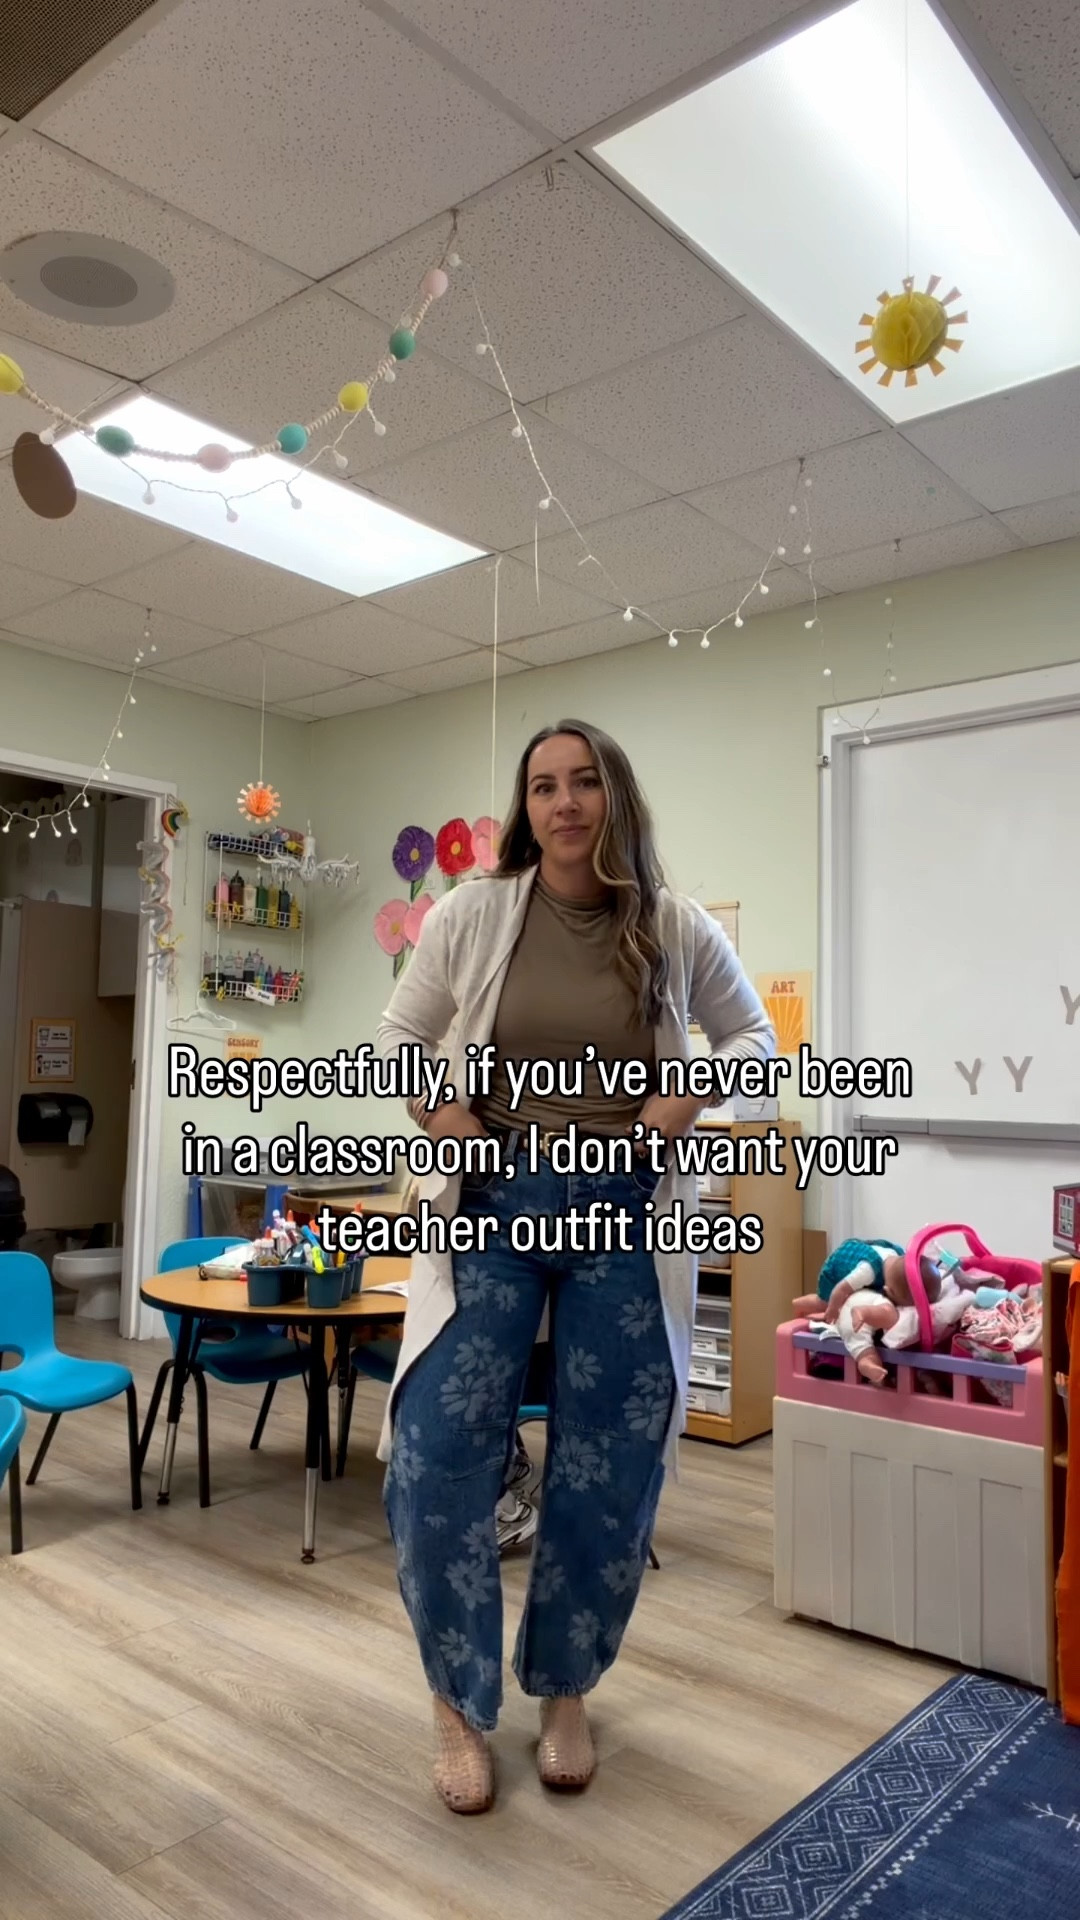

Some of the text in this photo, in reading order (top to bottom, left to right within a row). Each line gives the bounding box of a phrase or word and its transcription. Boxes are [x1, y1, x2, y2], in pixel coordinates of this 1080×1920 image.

[771, 980, 796, 994] ART
[1059, 984, 1080, 1025] Y
[954, 1055, 1033, 1096] Y Y
